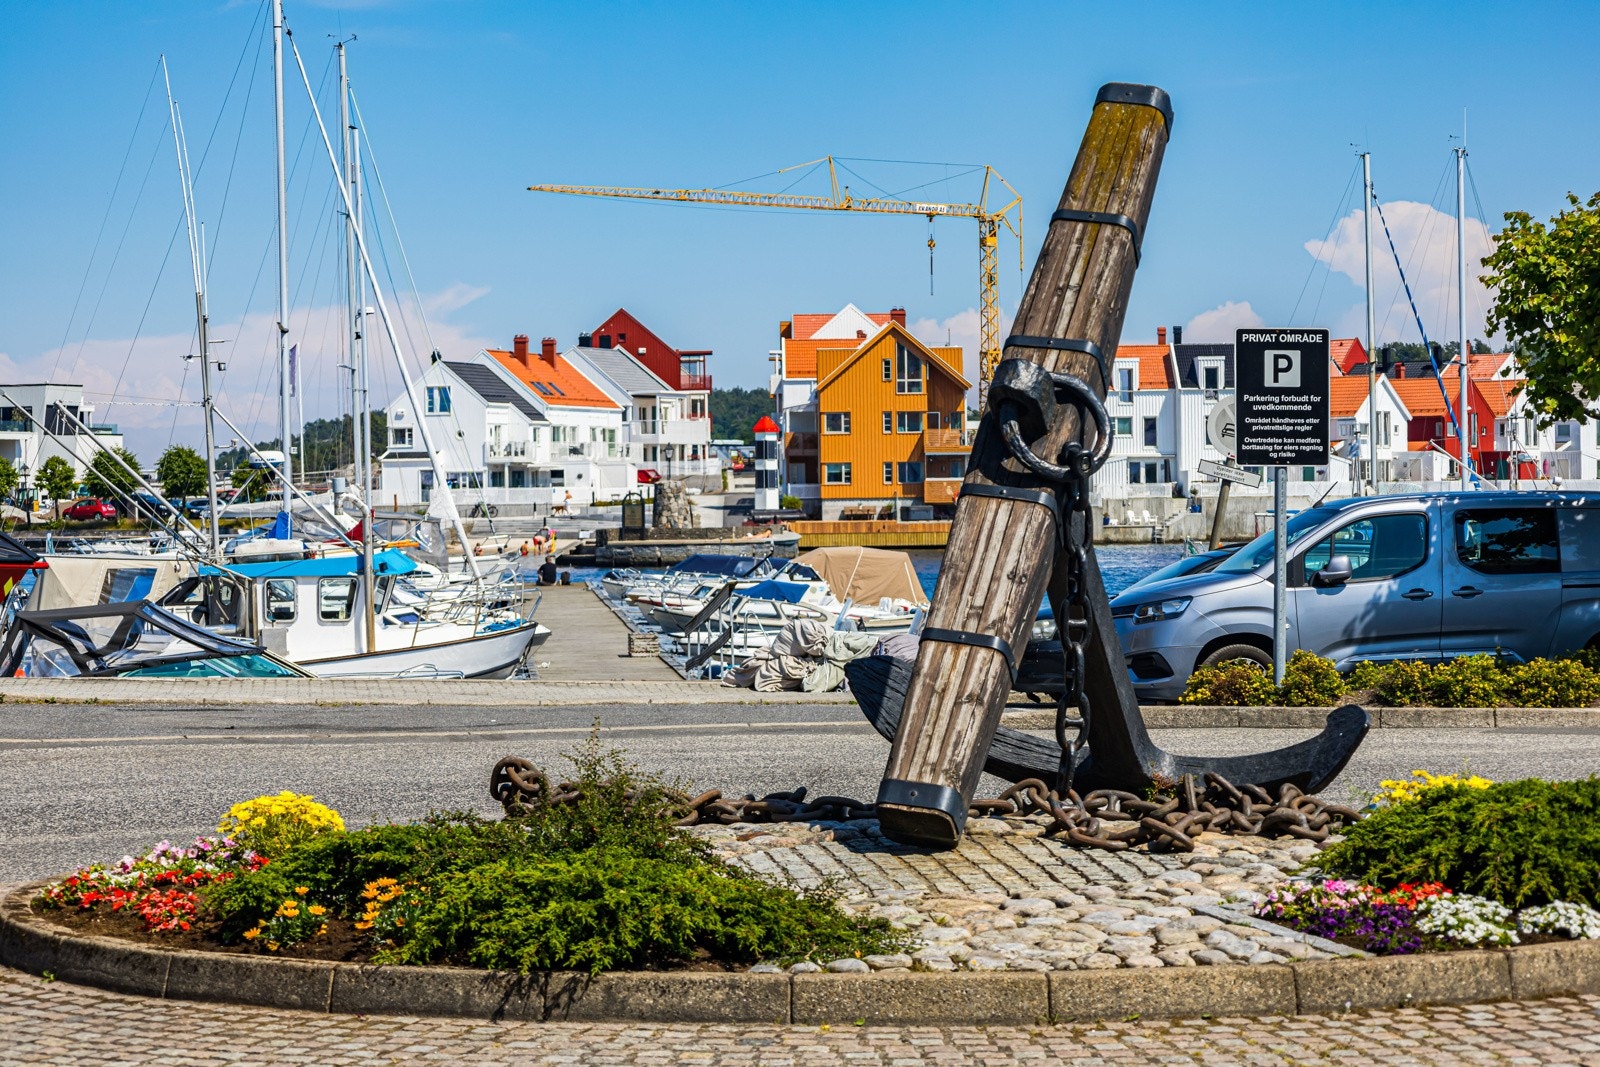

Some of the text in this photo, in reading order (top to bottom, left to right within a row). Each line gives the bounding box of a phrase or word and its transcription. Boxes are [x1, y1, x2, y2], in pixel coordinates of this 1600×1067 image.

[1242, 333, 1322, 342] PRIVAT OMRÅDE
[1273, 354, 1293, 383] P
[1244, 394, 1280, 403] Parkering
